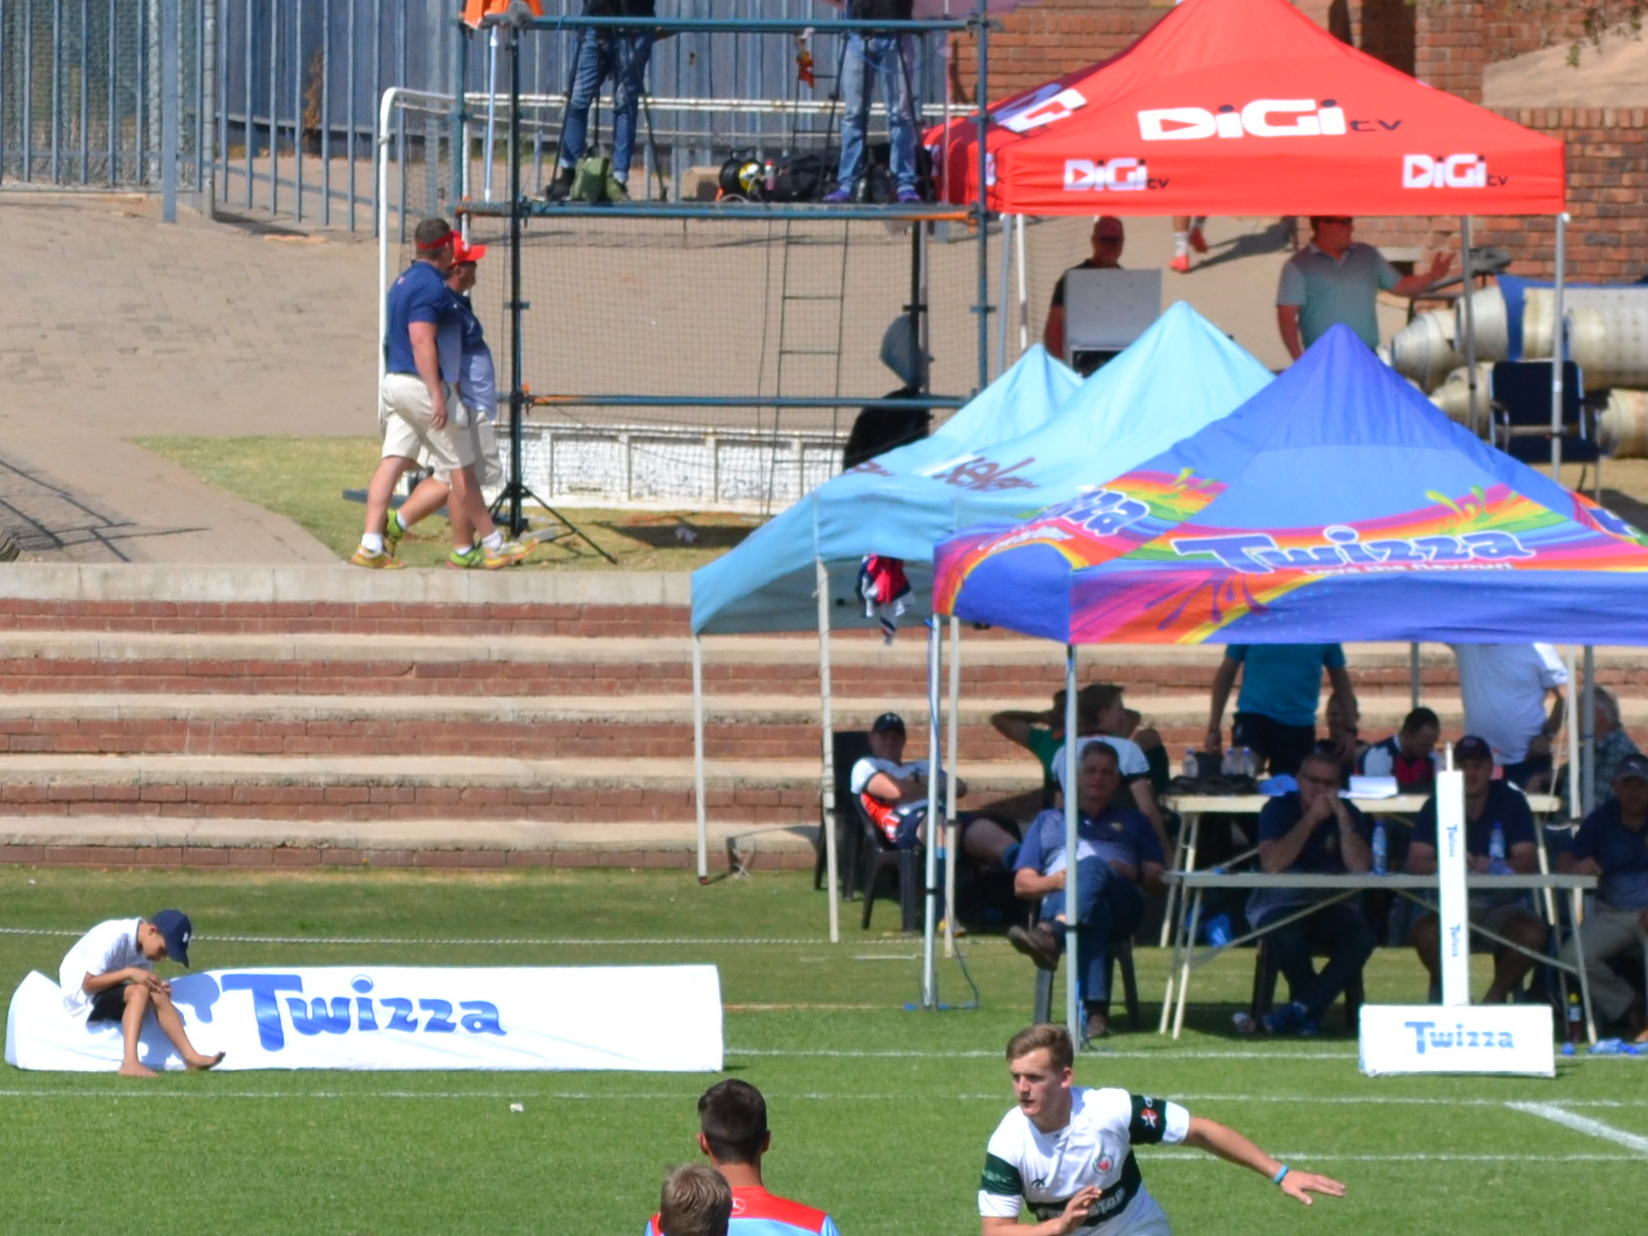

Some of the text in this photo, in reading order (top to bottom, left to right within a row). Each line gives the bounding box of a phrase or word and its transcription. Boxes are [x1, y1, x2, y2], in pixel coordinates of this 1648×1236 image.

[1170, 525, 1537, 574] Twizza
[220, 974, 508, 1052] Twizza
[1404, 1021, 1515, 1055] Twizza
